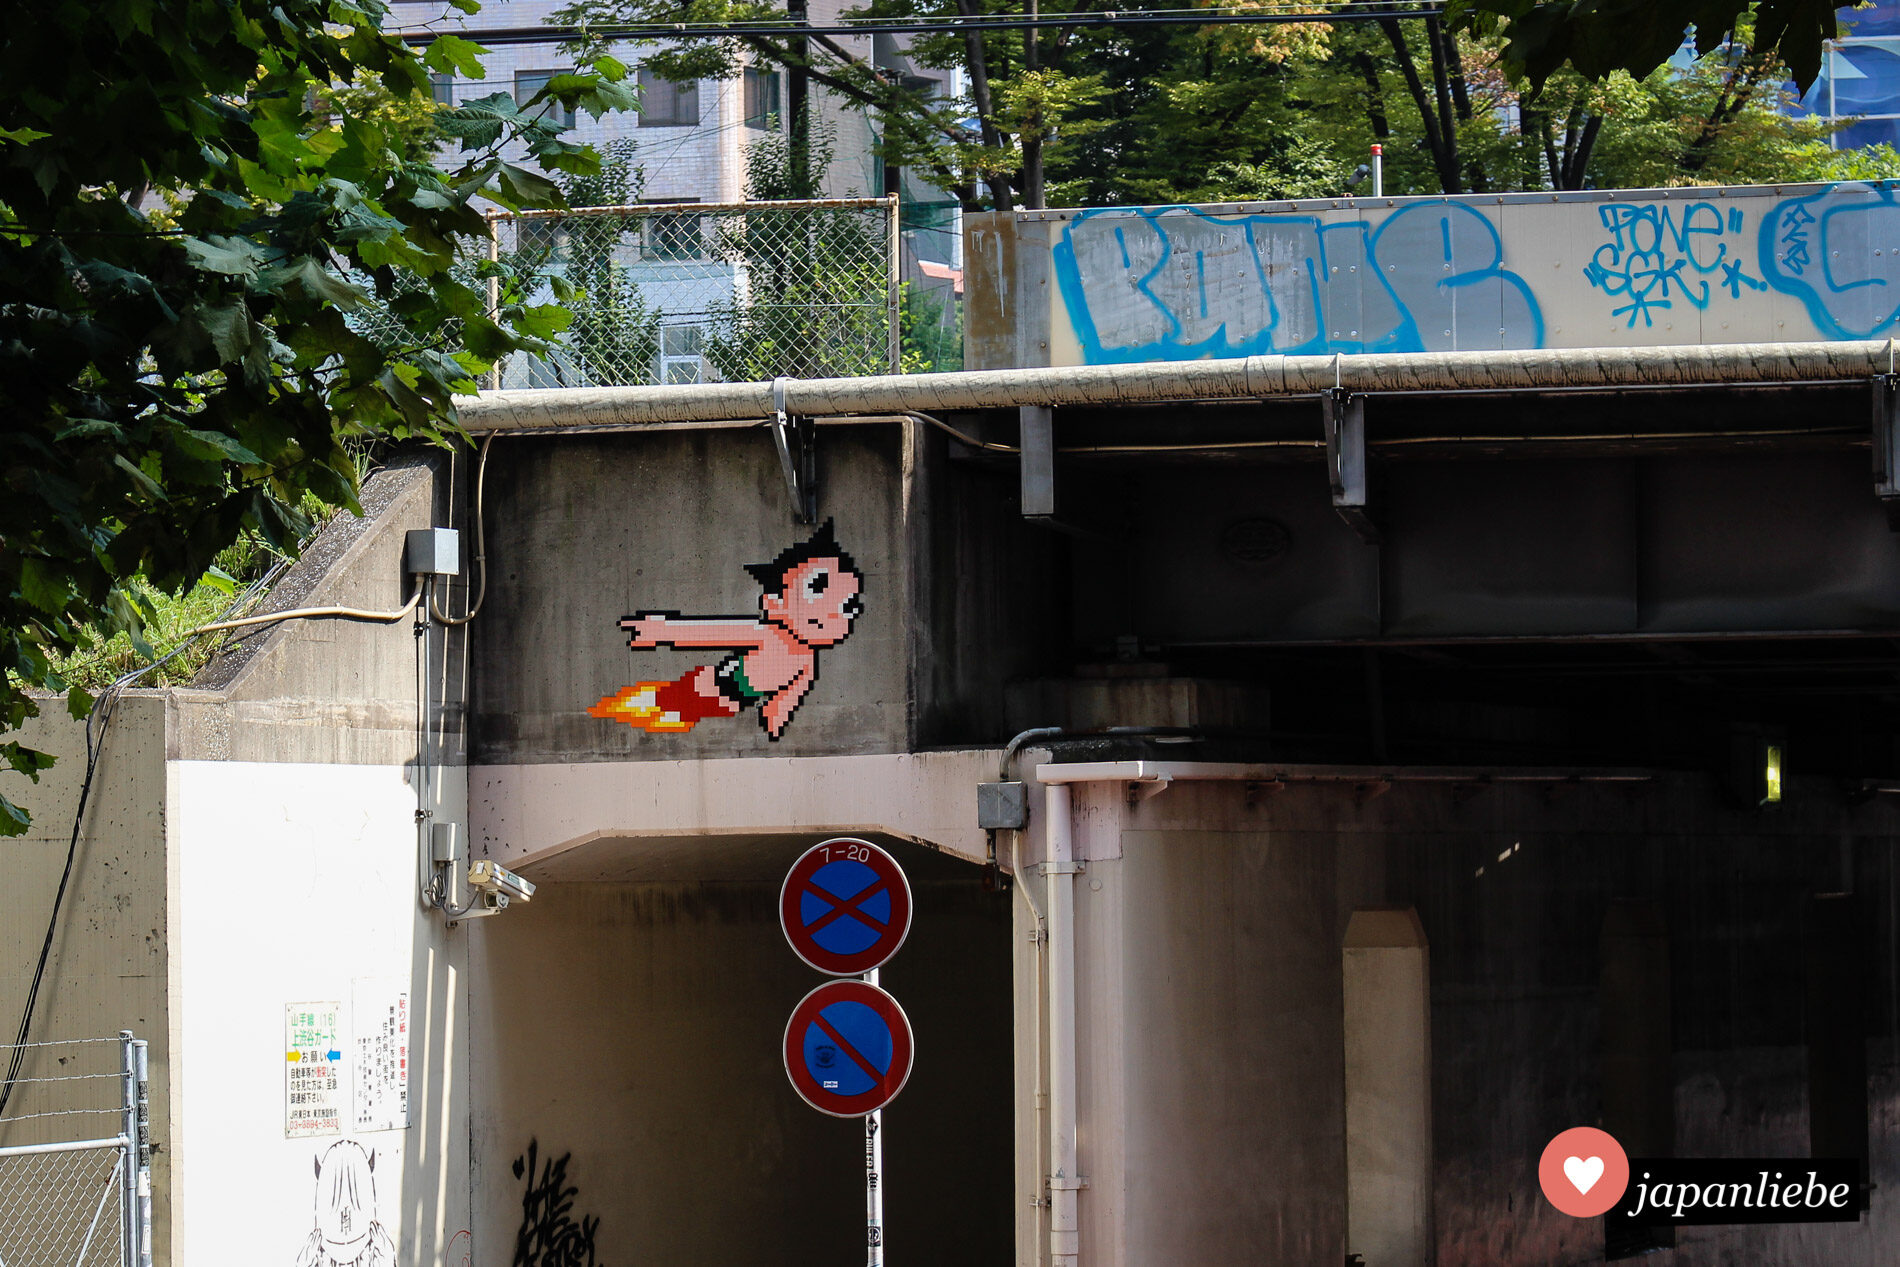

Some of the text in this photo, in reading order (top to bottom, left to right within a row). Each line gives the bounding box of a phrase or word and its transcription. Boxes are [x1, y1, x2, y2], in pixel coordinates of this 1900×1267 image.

[819, 844, 870, 863] 7-20
[301, 1050, 327, 1063] お願い
